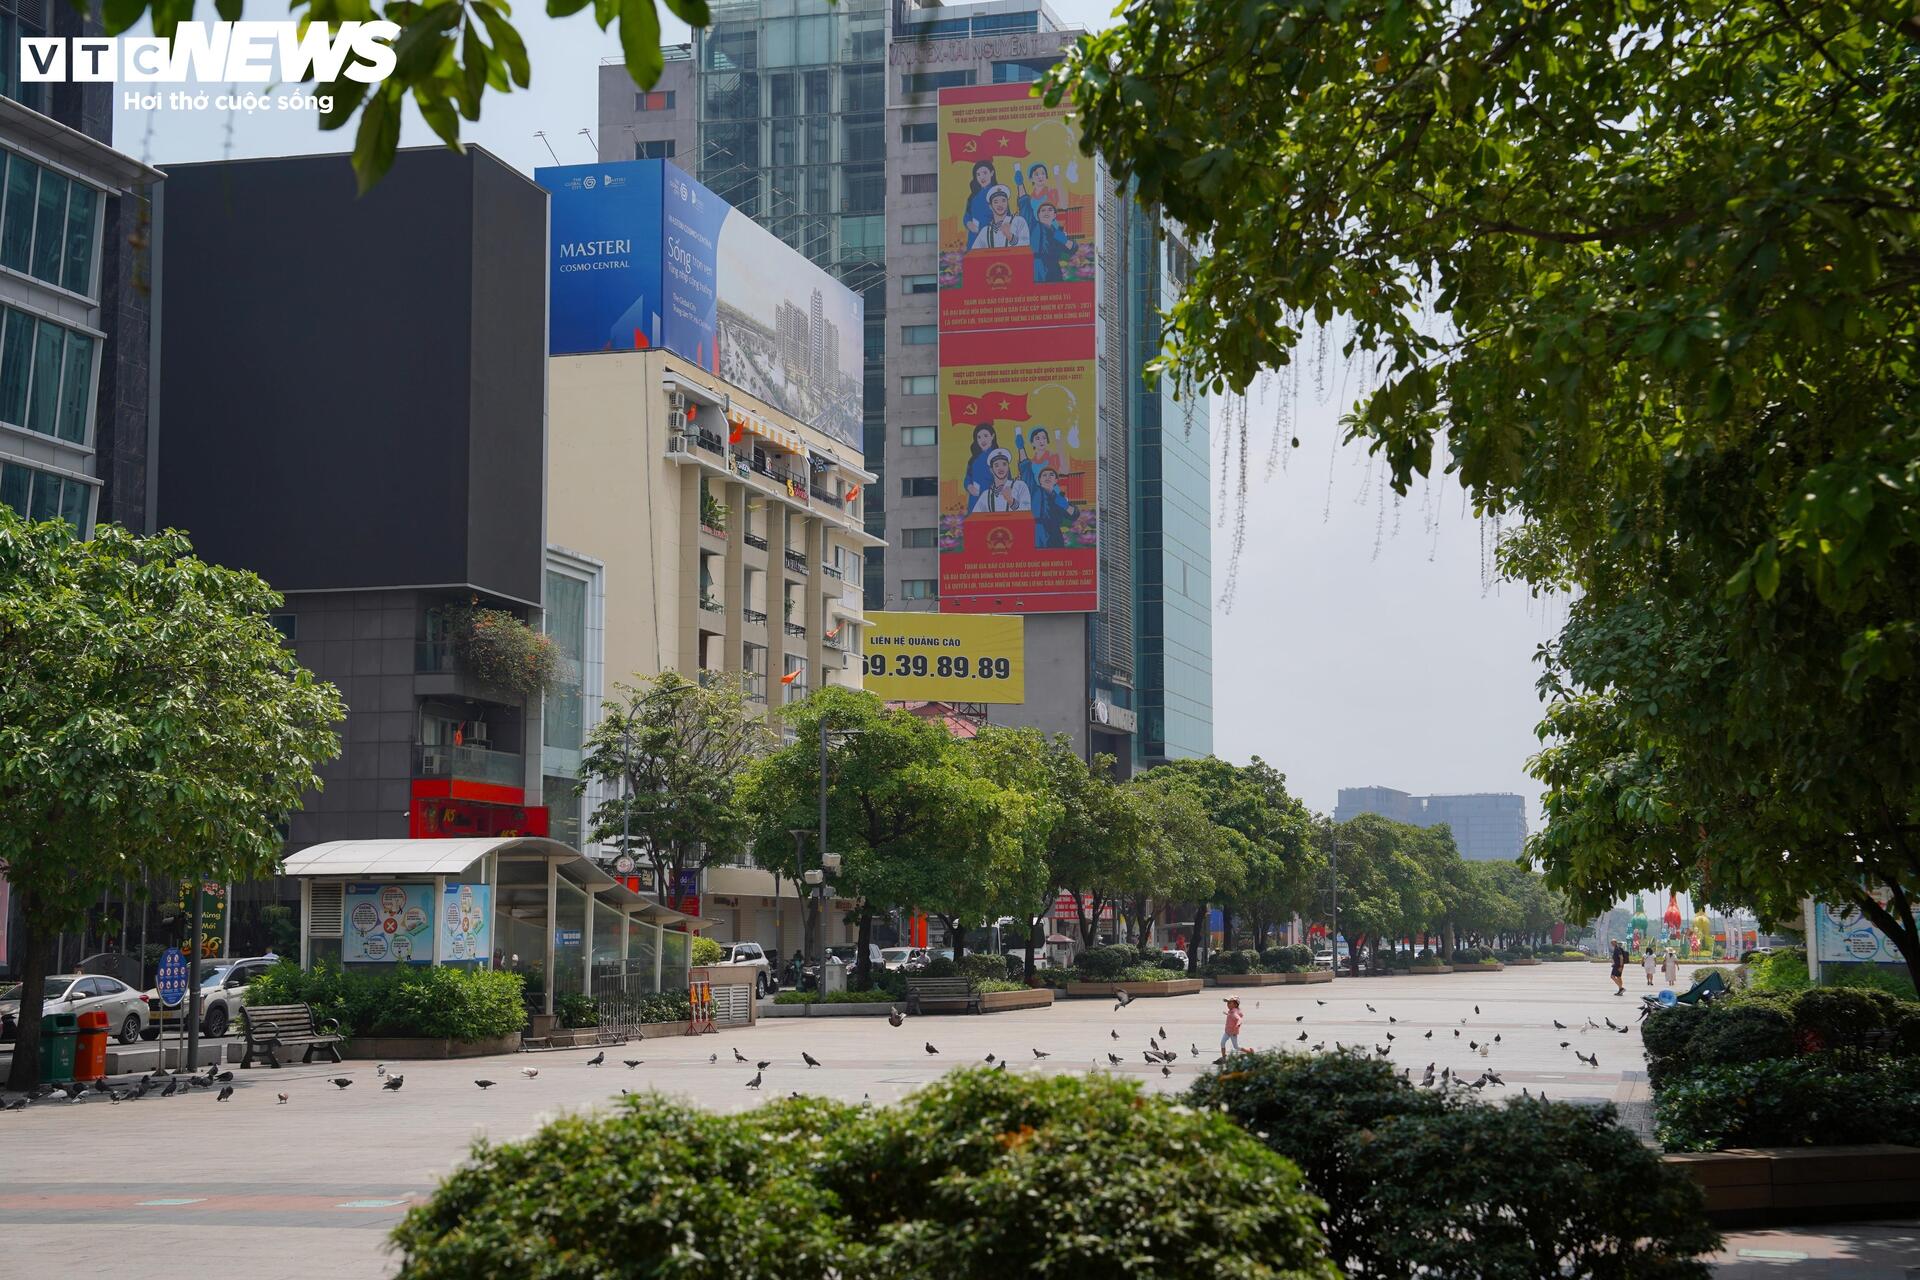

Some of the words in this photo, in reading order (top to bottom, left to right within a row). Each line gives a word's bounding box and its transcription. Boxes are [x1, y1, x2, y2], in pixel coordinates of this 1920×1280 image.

[560, 240, 631, 258] MASTERI
[668, 236, 692, 274] Sống
[560, 263, 591, 273] COSMO
[593, 260, 631, 270] CENTRAL
[894, 635, 905, 647] HỆ
[908, 635, 940, 647] QUẢNG
[943, 637, 961, 647] CÁO
